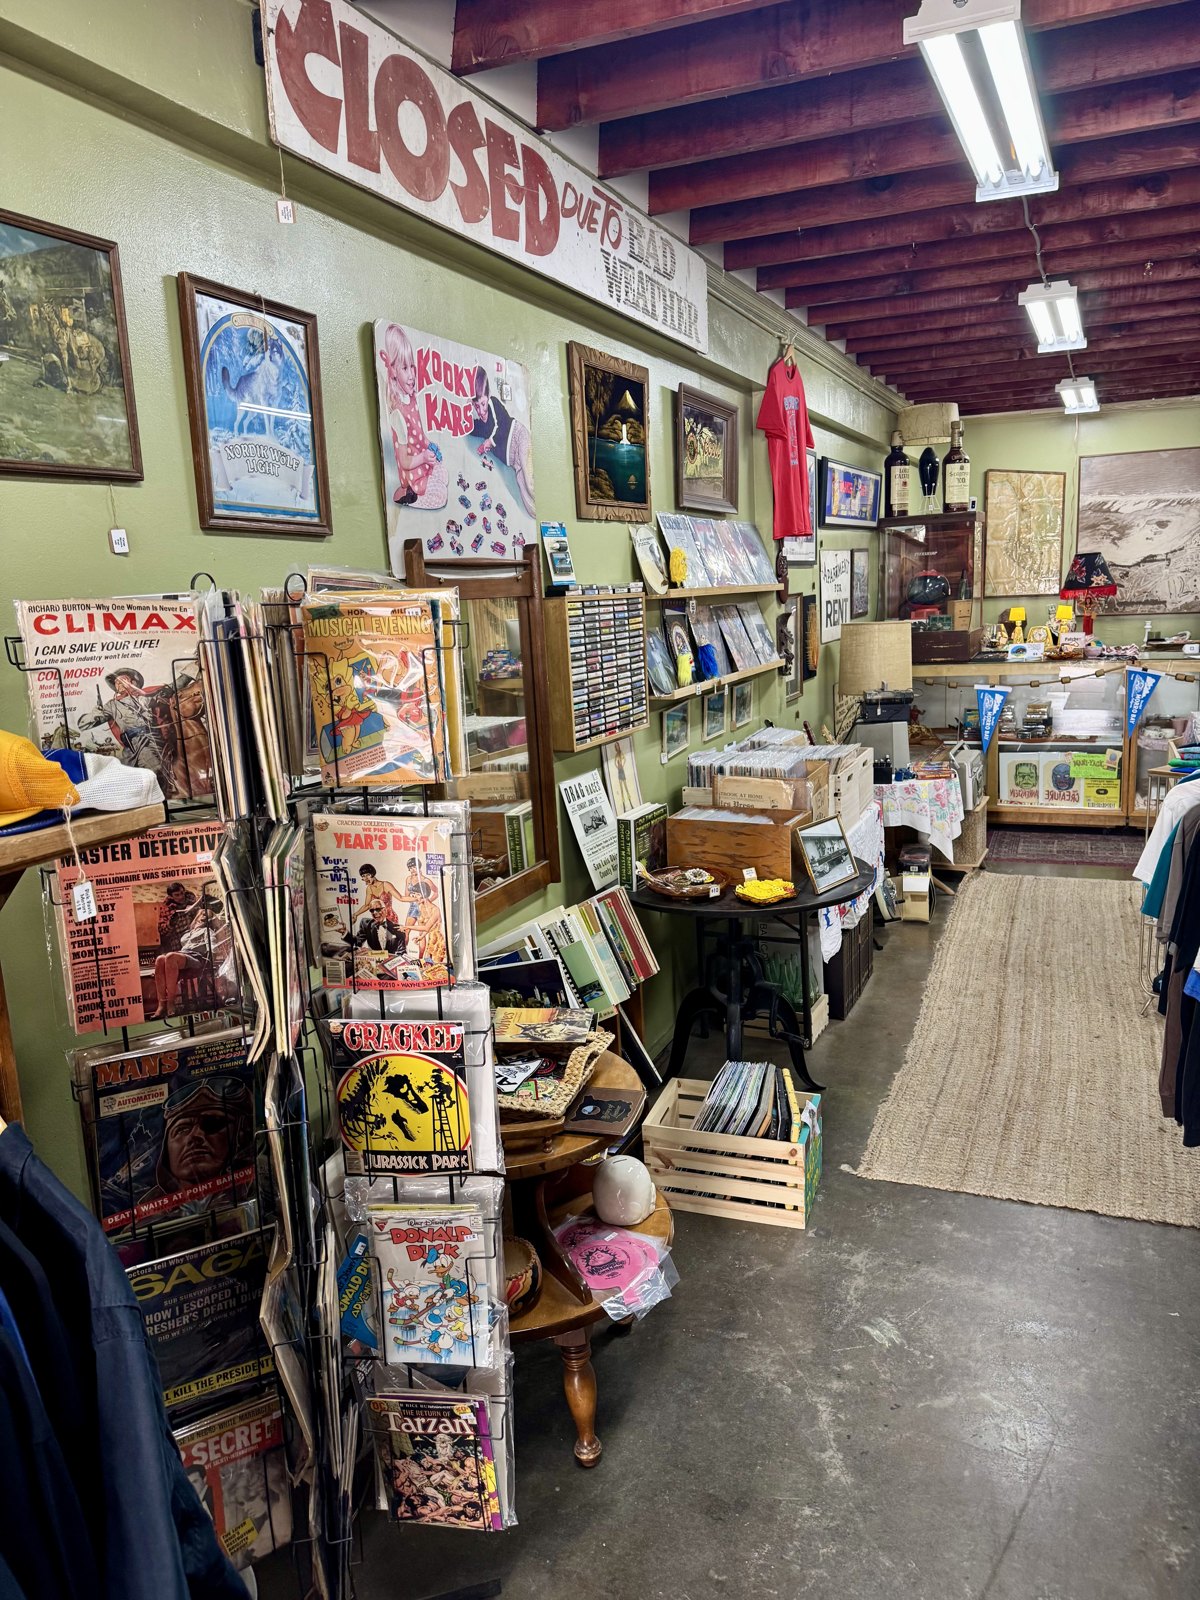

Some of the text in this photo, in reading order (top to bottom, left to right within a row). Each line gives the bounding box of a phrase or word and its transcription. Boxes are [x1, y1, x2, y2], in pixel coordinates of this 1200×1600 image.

[275, 0, 623, 256] CLOSED DUE TO
[625, 211, 677, 281] BAD
[601, 248, 701, 344] WEATHER
[416, 346, 478, 399] KOOKY
[424, 393, 475, 438] KARS
[225, 443, 268, 460] NORDIK
[247, 458, 280, 477] LIGHT
[28, 604, 60, 613] RICHARD
[825, 598, 848, 628] RENT
[33, 613, 196, 635] CLIMAX
[307, 617, 431, 637] MUSICAL EVENING
[34, 639, 160, 656] I CAN SAVE YOUR LIFE!
[64, 667, 104, 678] MOSBY
[1133, 694, 1142, 715] MORRO
[564, 781, 601, 804] DRAG RACES
[158, 828, 192, 838] California
[334, 833, 429, 852] YEAR'S BEST
[61, 842, 132, 868] MASTER
[96, 873, 141, 886] MILLIONAIRE
[142, 871, 159, 881] WAS
[161, 869, 180, 879] SHOT
[182, 868, 196, 877] FIVE
[600, 868, 613, 879] County
[97, 903, 116, 912] ABY
[101, 914, 114, 923] BE
[70, 926, 110, 938] DEAD IN
[71, 937, 103, 949] THREE
[75, 978, 115, 992] BURN THE
[76, 989, 116, 1003] FIELDS TO
[77, 995, 142, 1014] SMOKE OUT THE
[78, 1009, 129, 1024] COP-KILLER!
[343, 1023, 462, 1052] CRACKED
[95, 1051, 179, 1087] MAN'S
[191, 1060, 244, 1075] SEXUAL TIMING
[117, 1091, 165, 1107] AUTOMATION
[365, 1154, 469, 1170] JURASSICK PARK
[107, 1168, 252, 1224] DEATH WAITS AT POINT BARROW
[390, 1226, 472, 1244] DONALD
[128, 1267, 151, 1278] octors
[153, 1262, 166, 1273] Tell
[169, 1257, 184, 1267] Why
[185, 1252, 199, 1262] You
[200, 1246, 219, 1257] HAVE
[339, 1275, 362, 1317] ONALD
[146, 1309, 173, 1325] HOW
[176, 1306, 180, 1316] I
[183, 1290, 231, 1313] ESCAPED
[146, 1313, 199, 1336] RESHER'S
[203, 1298, 237, 1317] DEATH
[173, 1385, 192, 1397] KILL
[195, 1376, 214, 1390] THE
[381, 1411, 474, 1434] Tarzan
[191, 1417, 274, 1465] SECRET
